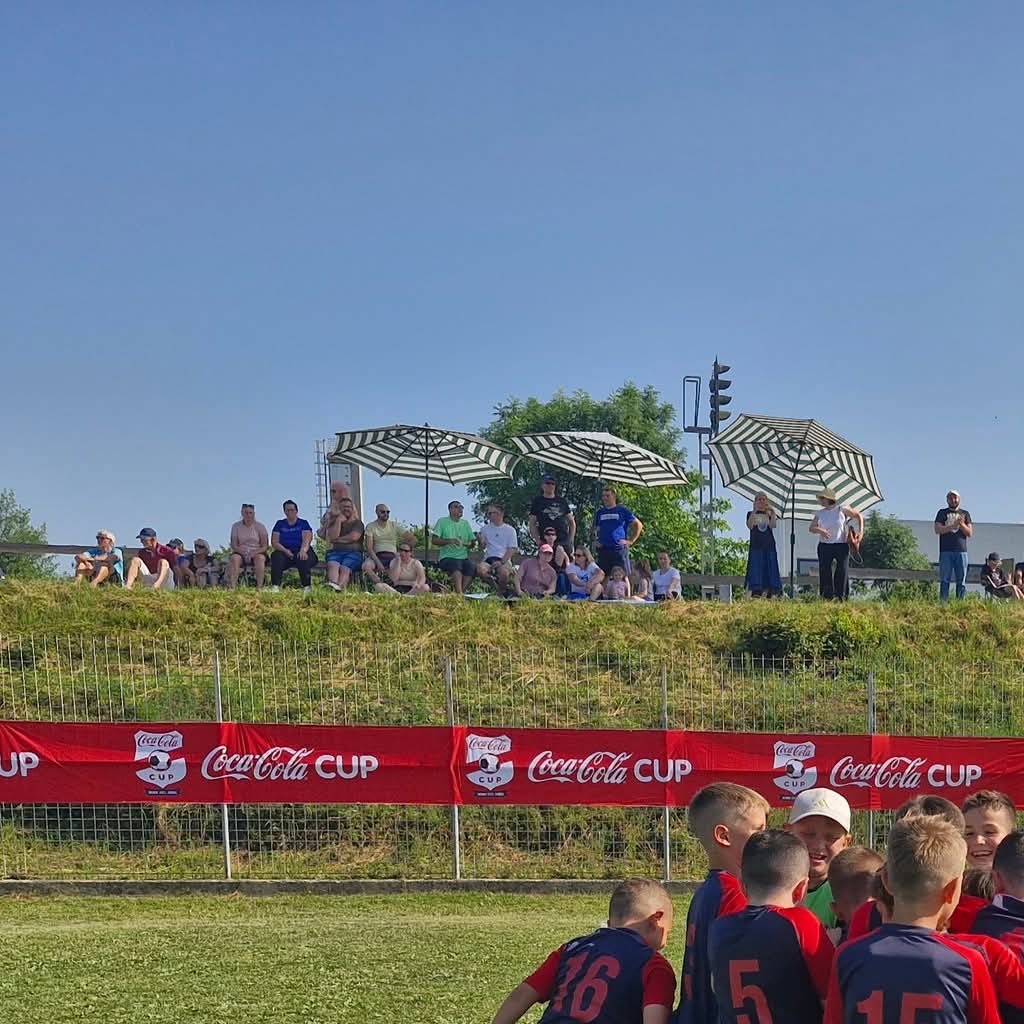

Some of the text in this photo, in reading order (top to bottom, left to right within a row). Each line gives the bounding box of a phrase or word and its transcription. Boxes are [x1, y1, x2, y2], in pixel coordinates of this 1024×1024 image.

[201, 745, 379, 781] Coca-Cola CUP
[527, 750, 693, 784] Coca-Cola CUP
[829, 756, 983, 789] Coca-Cola CUP
[552, 951, 621, 1024] 16
